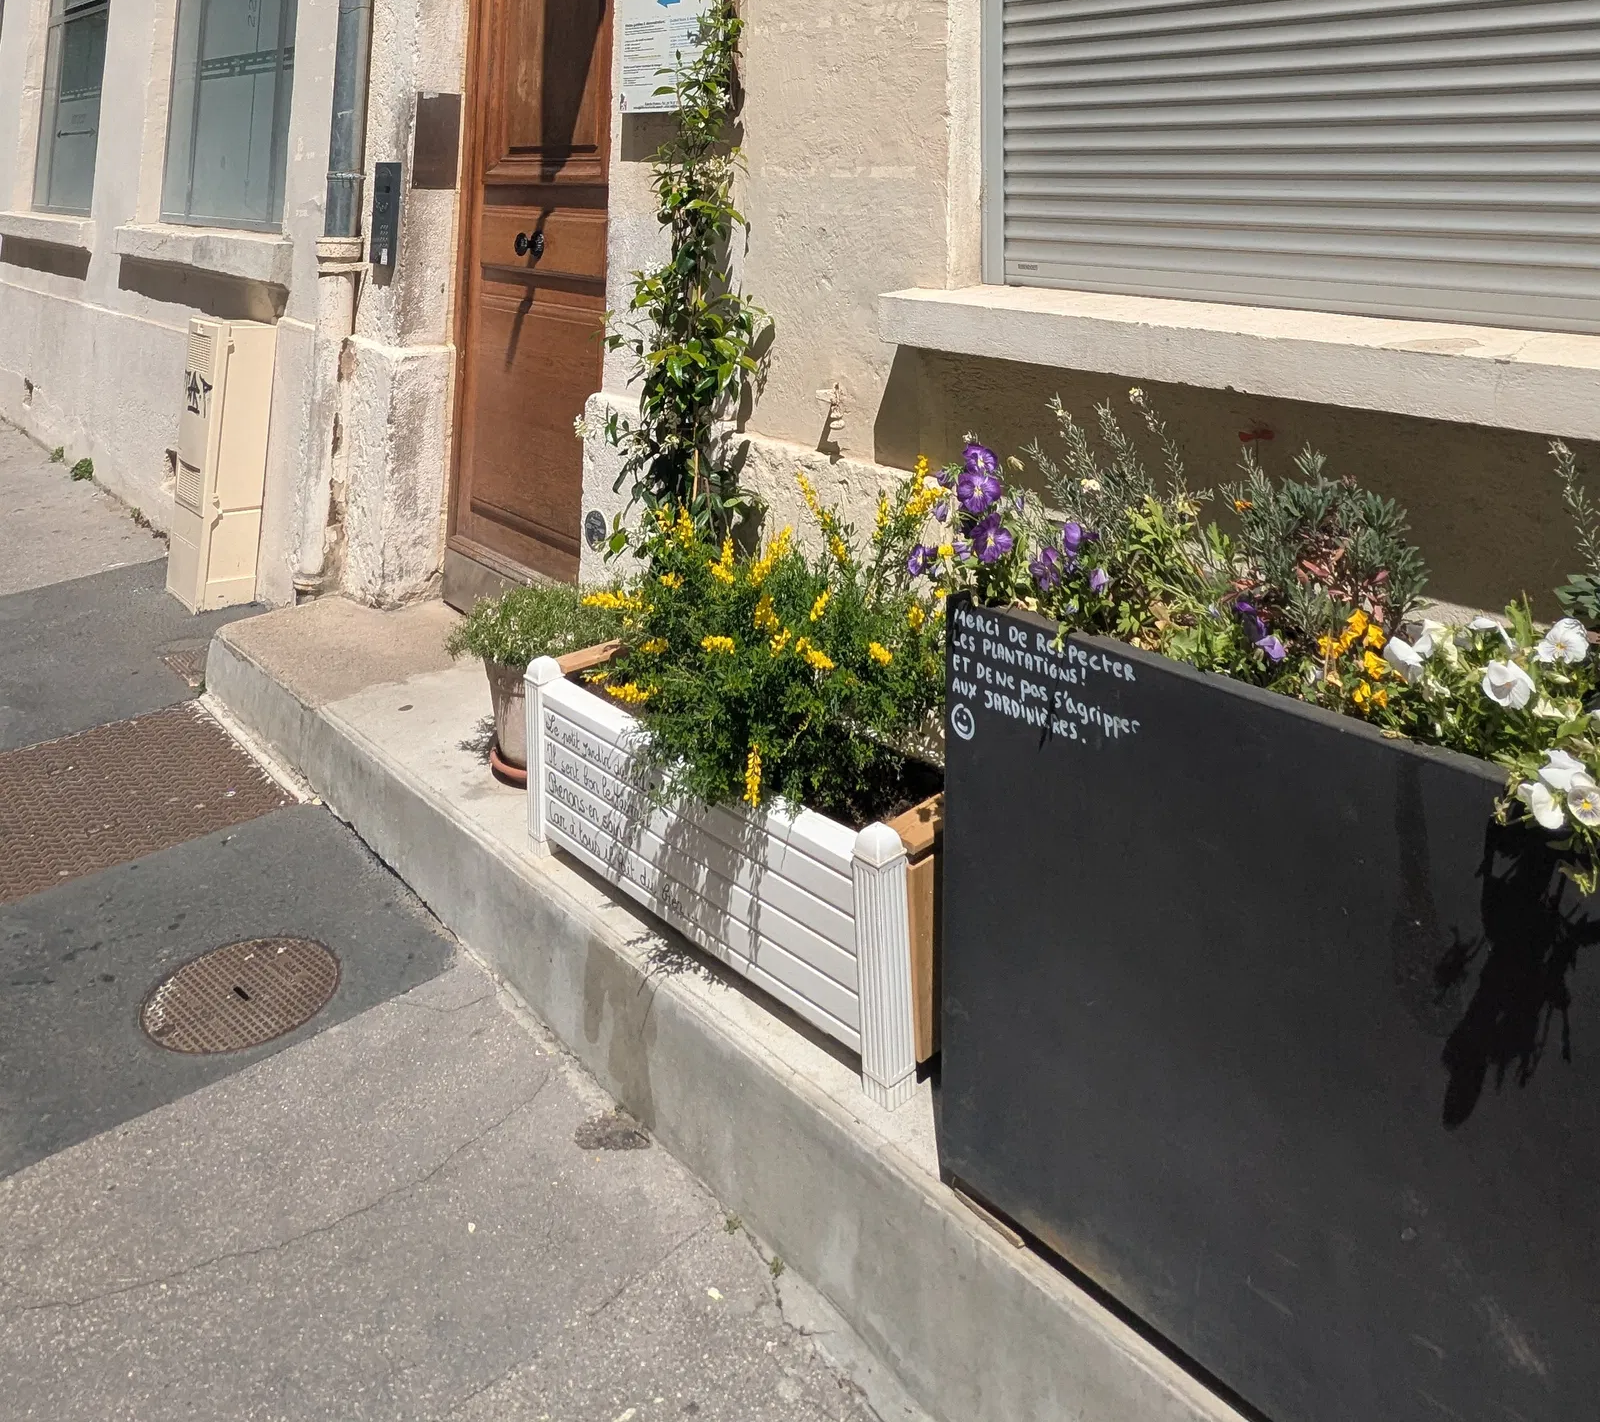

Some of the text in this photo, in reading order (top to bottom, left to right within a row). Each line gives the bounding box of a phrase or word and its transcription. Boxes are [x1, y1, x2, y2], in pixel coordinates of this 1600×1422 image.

[952, 677, 977, 700] AUX
[953, 654, 971, 673] ET
[1054, 690, 1141, 739] s'agripper
[561, 760, 579, 781] sent
[583, 765, 600, 794] bon
[550, 800, 567, 830] Car
